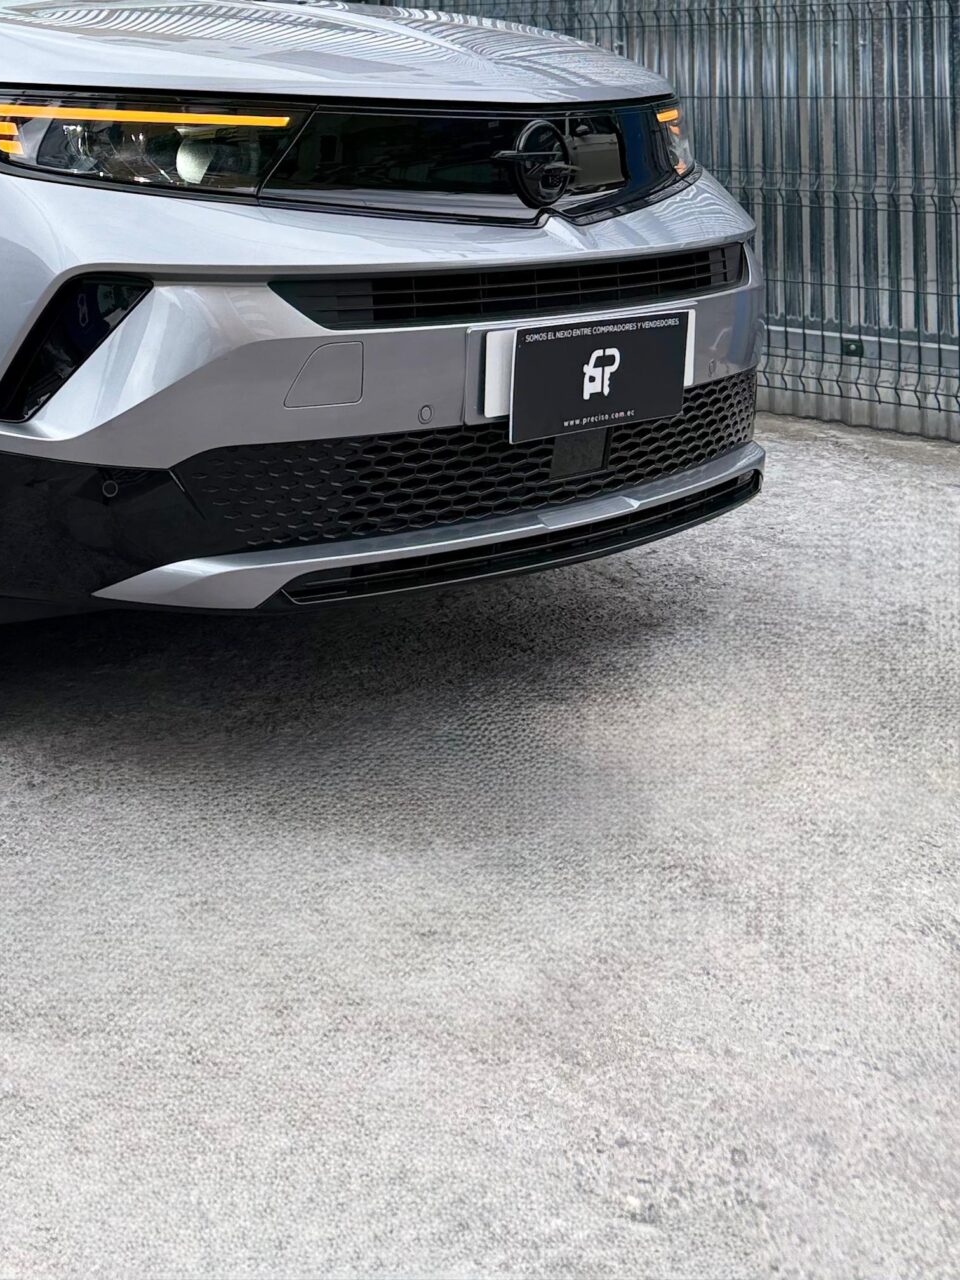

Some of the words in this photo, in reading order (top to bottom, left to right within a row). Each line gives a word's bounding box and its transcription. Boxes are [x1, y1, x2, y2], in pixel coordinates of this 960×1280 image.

[525, 332, 547, 343] SOMOS
[547, 331, 555, 340] EL
[555, 329, 572, 339] NEXO
[572, 327, 592, 337] ENTRE
[592, 322, 637, 335] COMPRADORES
[642, 318, 680, 329] VENDEDORES
[563, 410, 634, 426] www.preciso.com.ec
